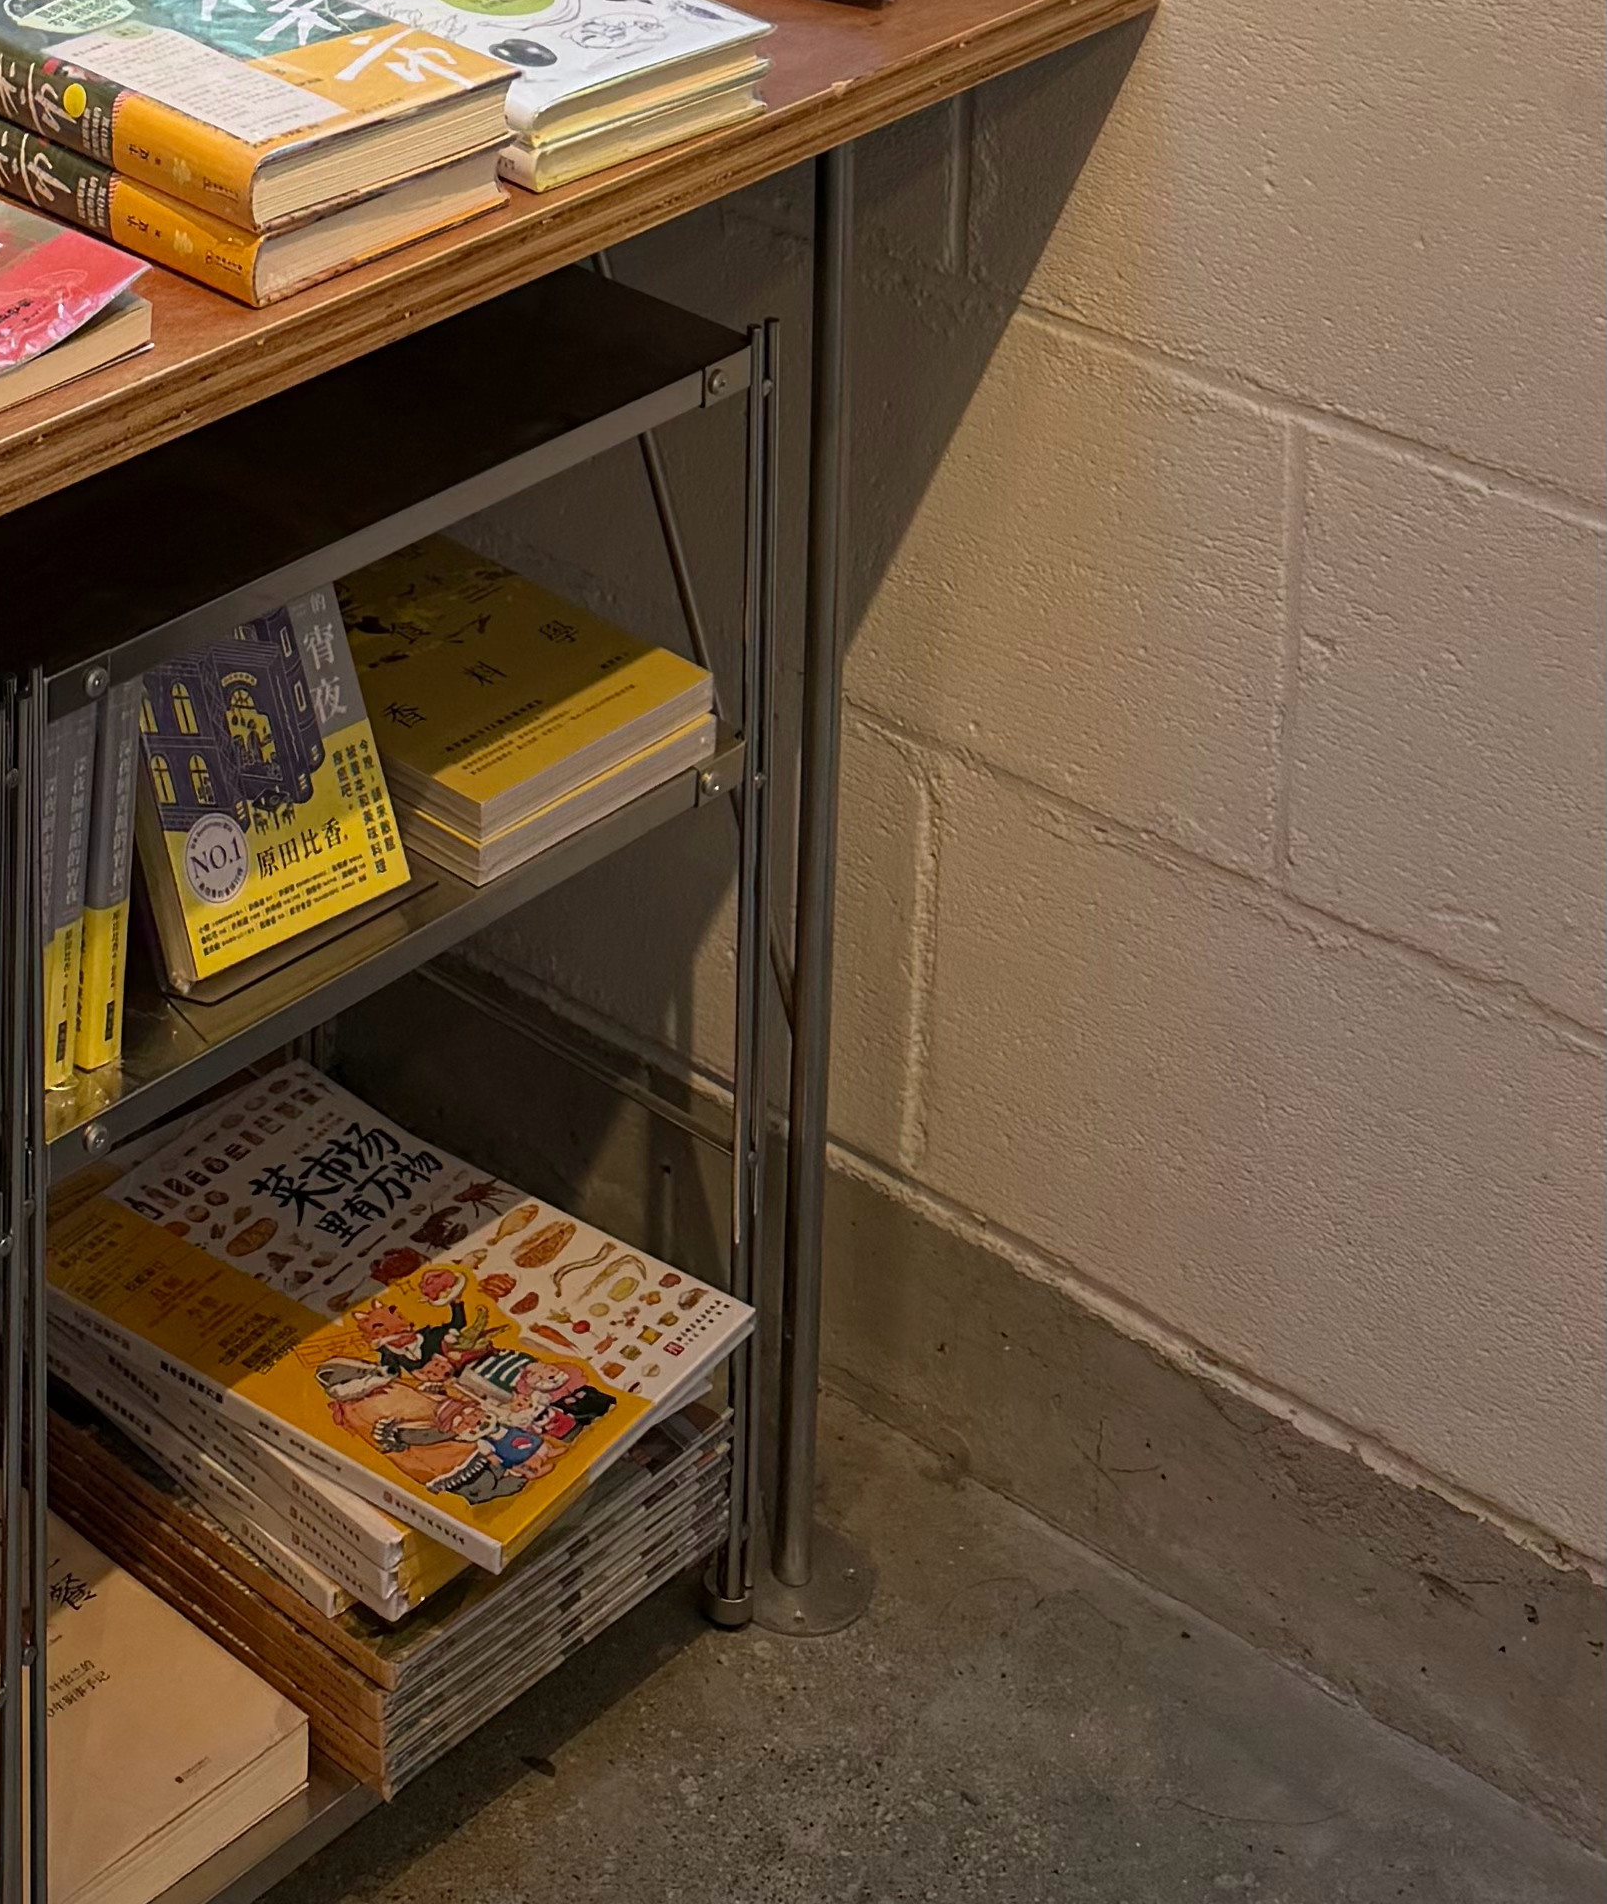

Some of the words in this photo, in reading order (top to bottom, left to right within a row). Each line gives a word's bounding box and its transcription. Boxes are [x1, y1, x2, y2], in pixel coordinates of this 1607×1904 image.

[190, 835, 244, 880] NO.1
[247, 1121, 402, 1227] 菜市场
[314, 1147, 445, 1248] 里有万物
